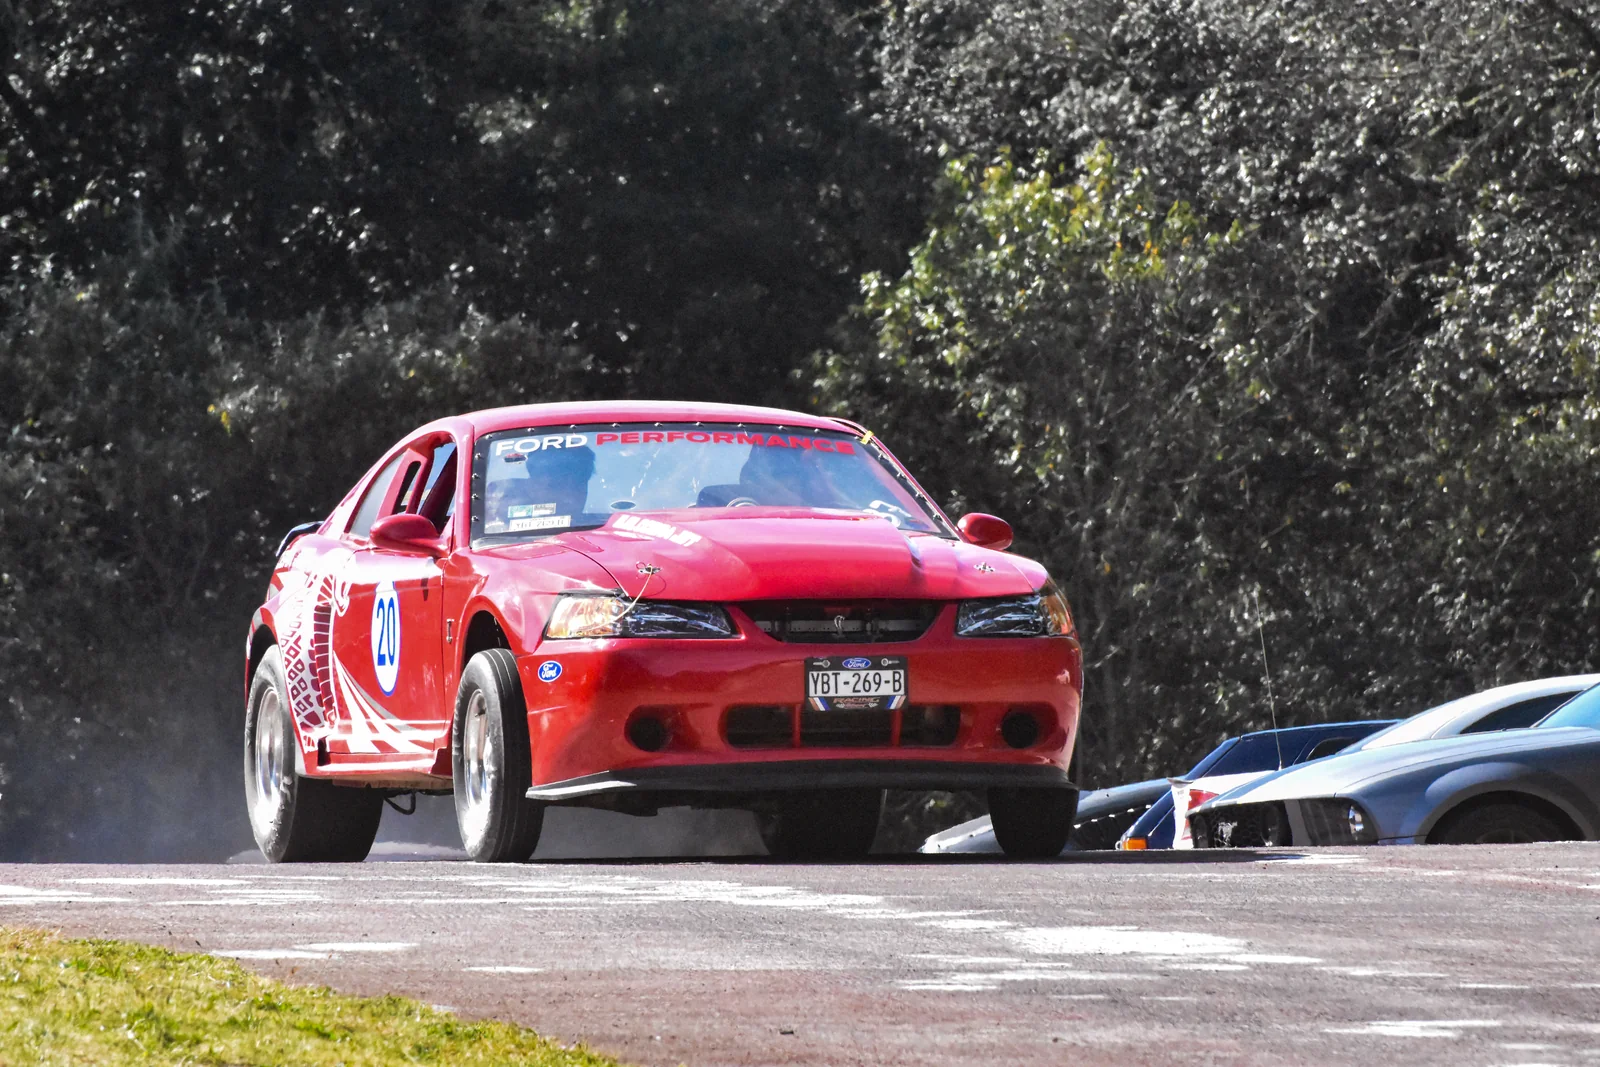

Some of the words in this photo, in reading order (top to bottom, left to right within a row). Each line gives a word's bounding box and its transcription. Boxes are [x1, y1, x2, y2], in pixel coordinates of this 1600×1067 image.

[495, 433, 588, 456] FORD
[596, 431, 856, 455] PERFORMANCE
[376, 597, 396, 666] 20
[541, 663, 558, 679] Ford
[810, 671, 902, 695] YBT-269-B
